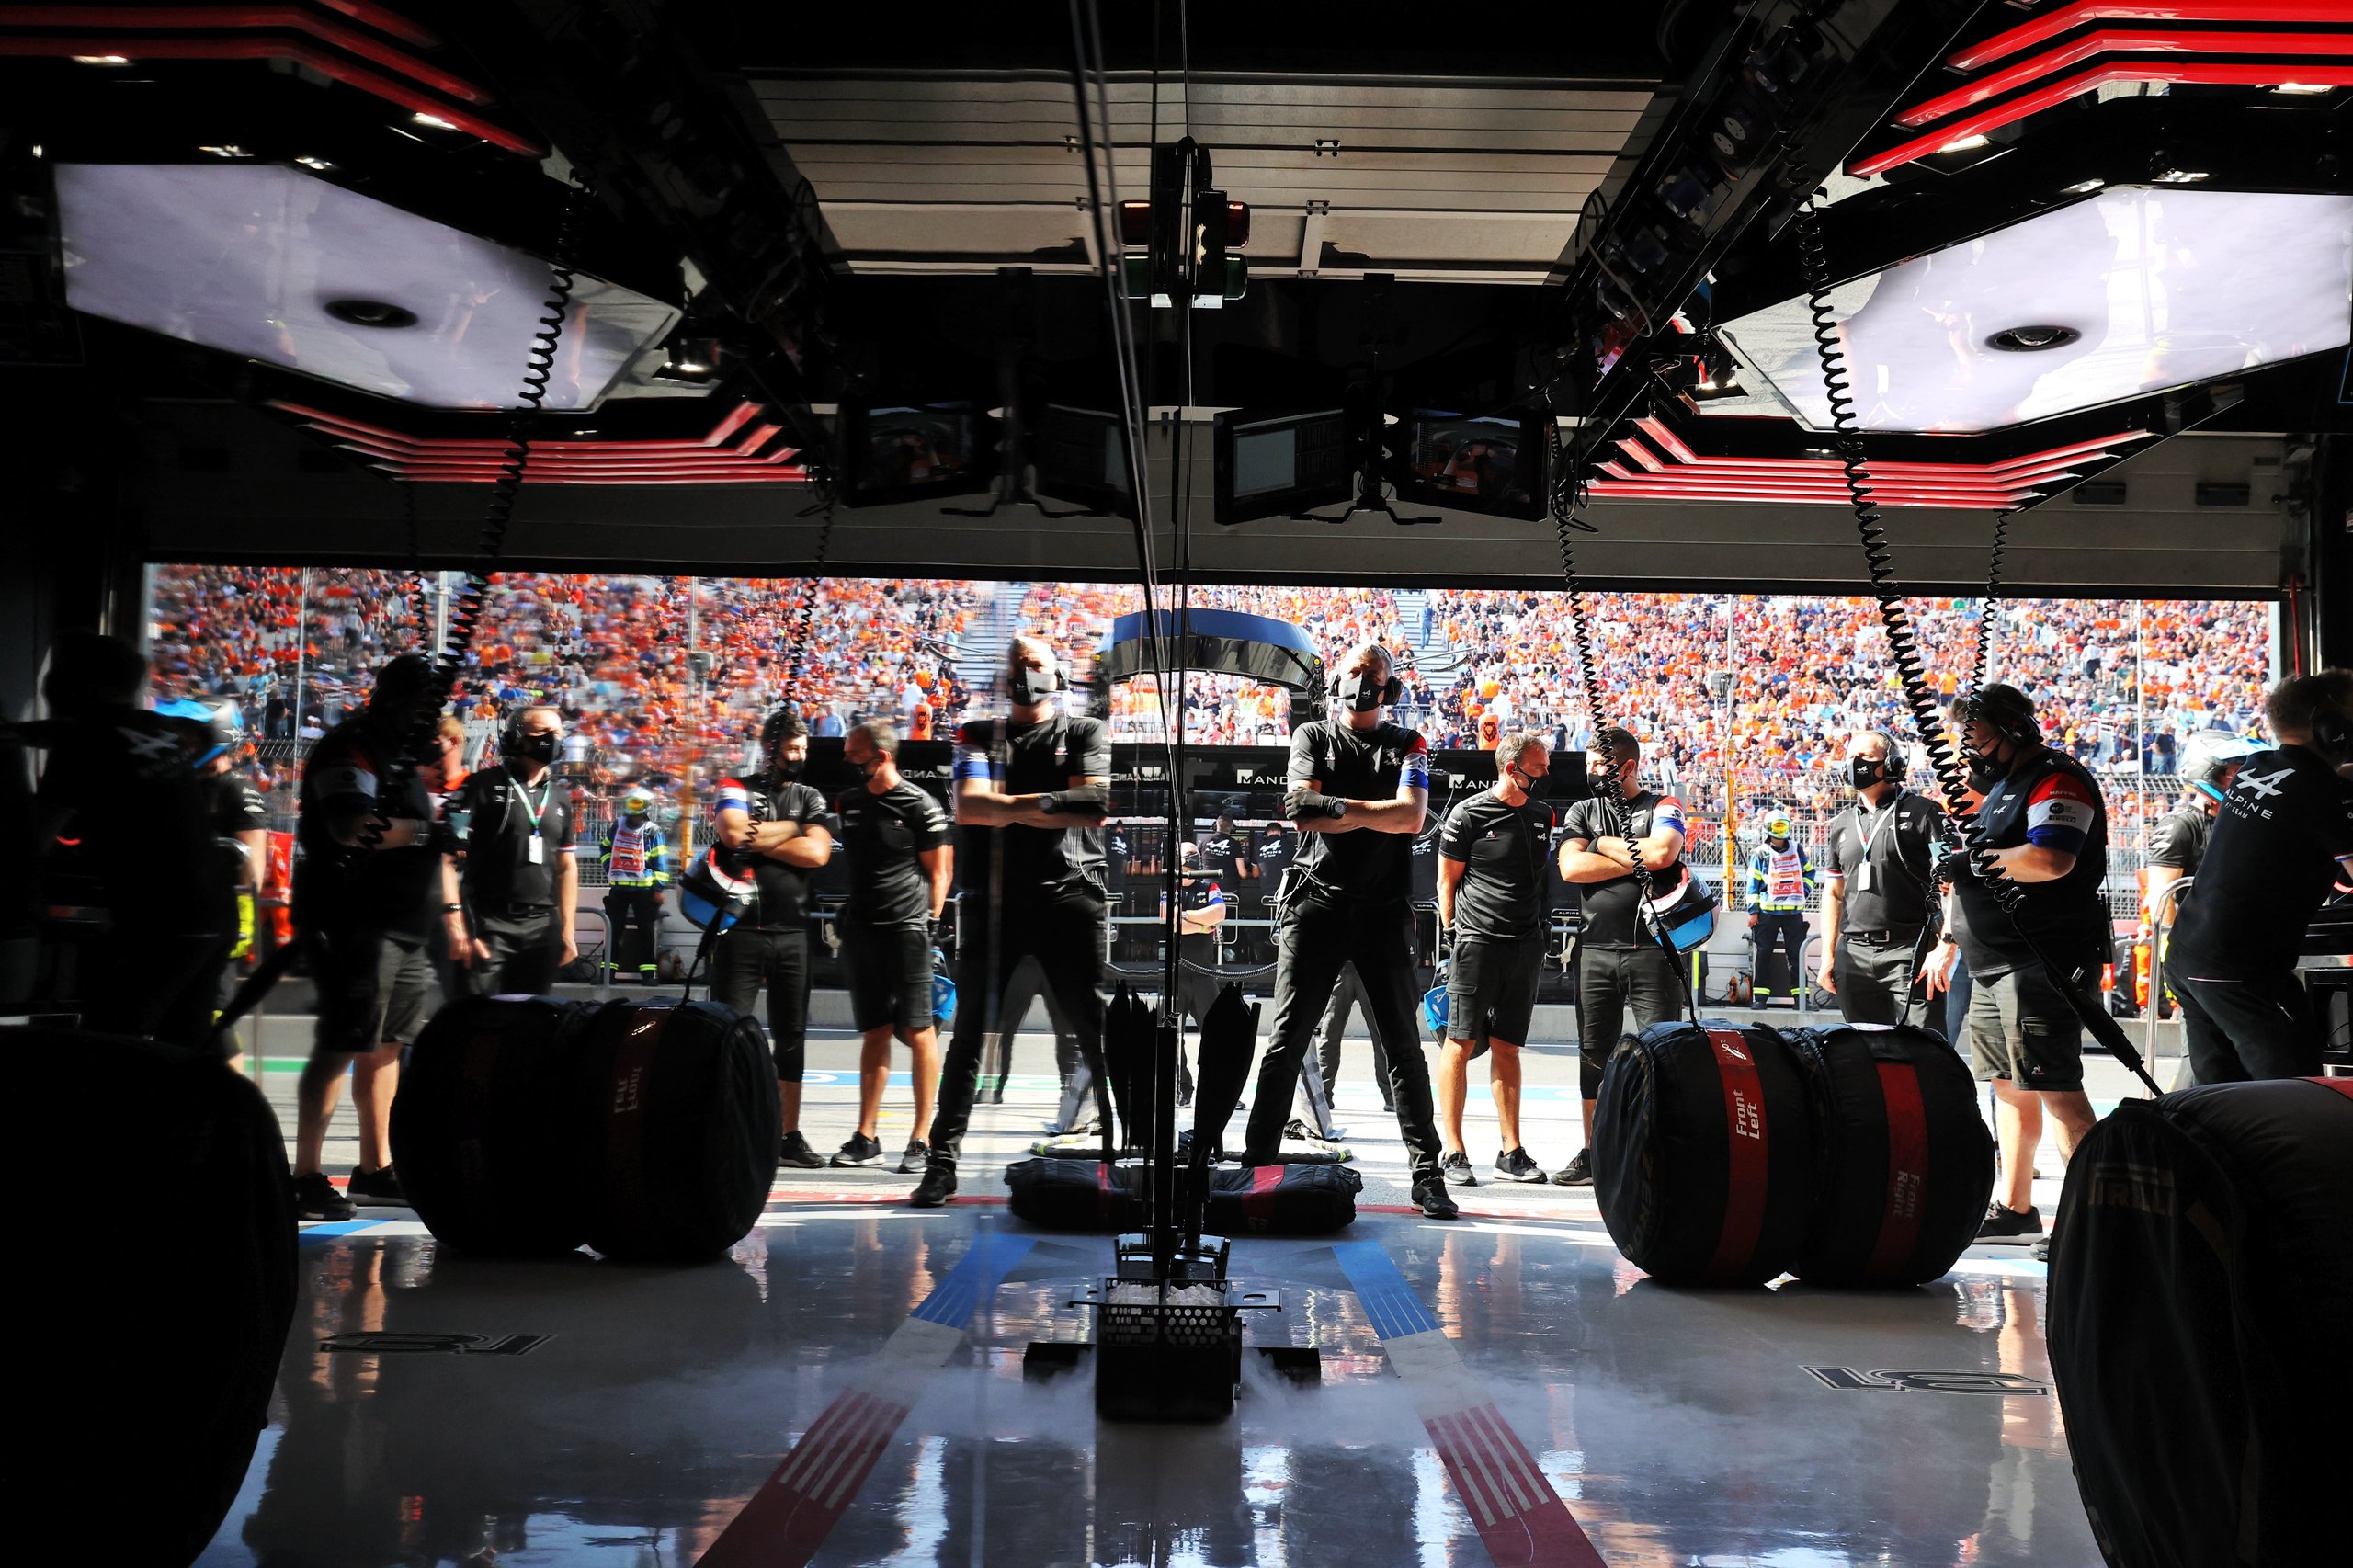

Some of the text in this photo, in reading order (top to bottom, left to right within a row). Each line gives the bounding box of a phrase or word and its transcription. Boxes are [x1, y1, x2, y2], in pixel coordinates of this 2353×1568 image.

[2224, 788, 2274, 821] ALPINE
[2231, 807, 2249, 820] TEAM
[1734, 1089, 1749, 1136] Front
[1747, 1102, 1761, 1140] Left
[1893, 1170, 1908, 1218] Right
[1904, 1173, 1921, 1221] Front
